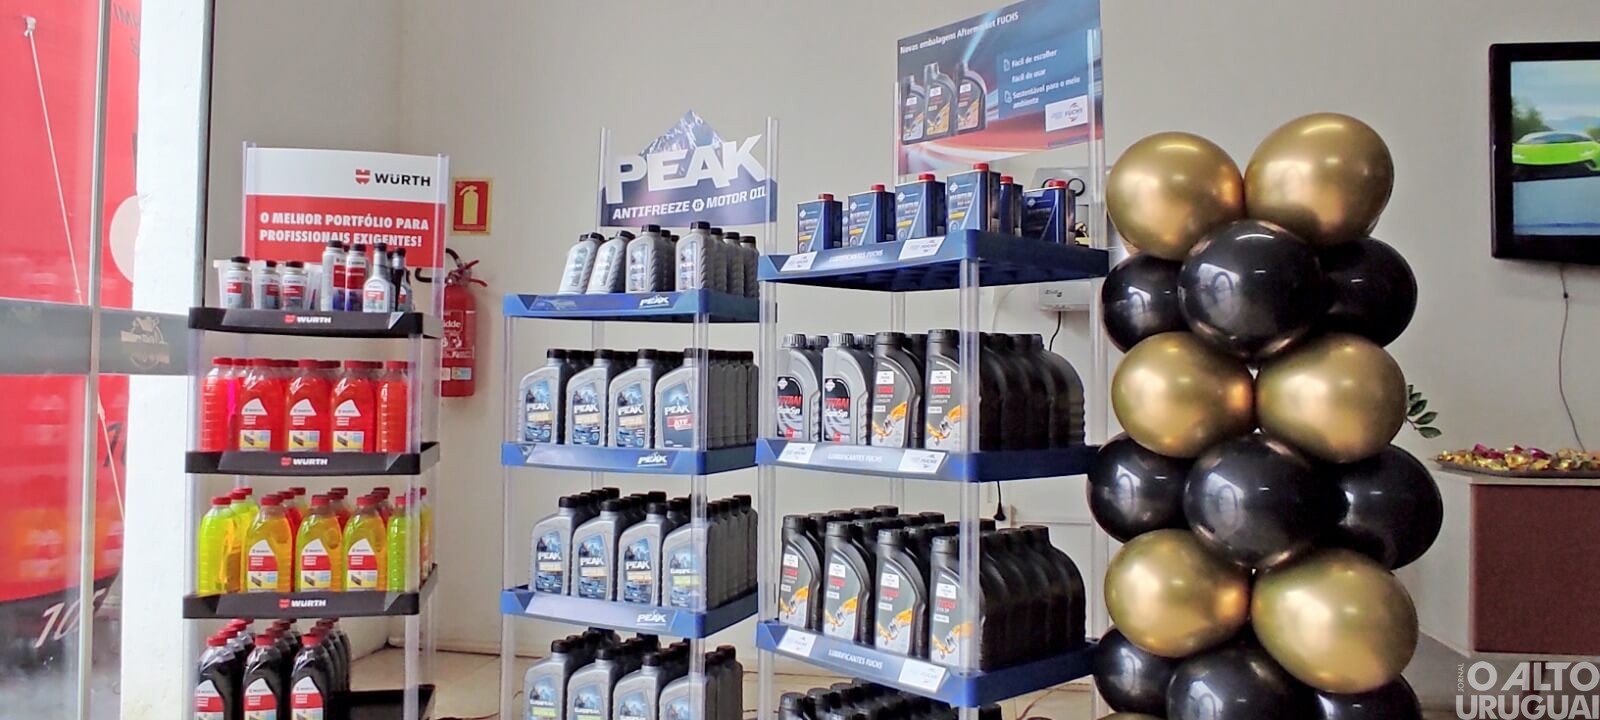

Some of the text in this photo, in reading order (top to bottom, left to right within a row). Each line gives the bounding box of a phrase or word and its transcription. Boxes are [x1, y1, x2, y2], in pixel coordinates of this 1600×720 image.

[919, 33, 957, 46] embalagens
[996, 11, 1019, 26] FUCHS
[1045, 82, 1059, 93] para
[1065, 75, 1081, 86] meio
[603, 134, 766, 204] PEAK
[374, 172, 431, 187] WÜRTH
[612, 200, 690, 220] ANTIFREEZE
[706, 191, 747, 210] MOTOR
[749, 186, 766, 201] OIL
[260, 211, 429, 231] O MELHOR PORTFÓLIO PARA
[259, 230, 422, 247] PROFISSIONAIS EXIGENTES!
[639, 295, 670, 307] PEAK
[526, 402, 550, 412] PEAK
[573, 403, 599, 414] PEAK
[617, 404, 644, 416] PEAK
[664, 405, 690, 416] PEAK
[637, 454, 669, 465] PEAK
[538, 551, 562, 561] PEAK
[580, 556, 605, 567] PEAK
[625, 560, 651, 570] PEAK
[637, 612, 667, 623] PEAK
[828, 648, 883, 670] LUBRIFICANTES FUCHS
